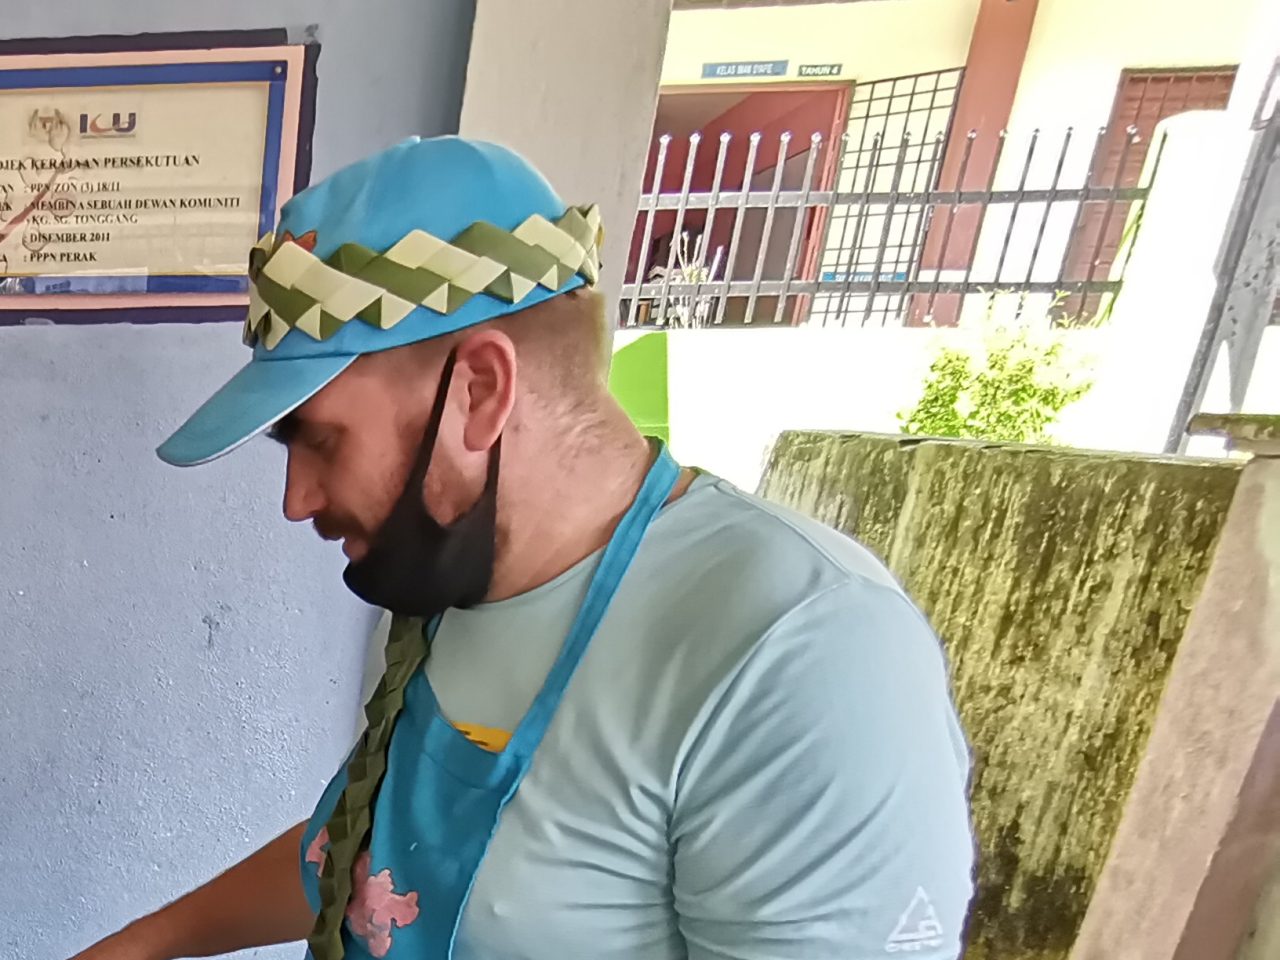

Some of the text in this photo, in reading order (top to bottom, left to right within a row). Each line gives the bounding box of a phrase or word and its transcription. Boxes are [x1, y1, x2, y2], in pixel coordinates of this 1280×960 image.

[802, 65, 839, 75] TAHUN 4
[31, 157, 99, 171] KERAJAAN
[104, 155, 200, 168] PERSEKUTUAN
[87, 199, 132, 210] SEBUAH
[135, 199, 176, 209] DEWAN
[180, 197, 240, 208] KOMUNITI
[74, 213, 138, 225] TONGGANG
[30, 232, 87, 243] DISEMBER
[90, 232, 110, 242] 2011
[30, 252, 57, 262] PPPN
[60, 252, 97, 262] PERAK
